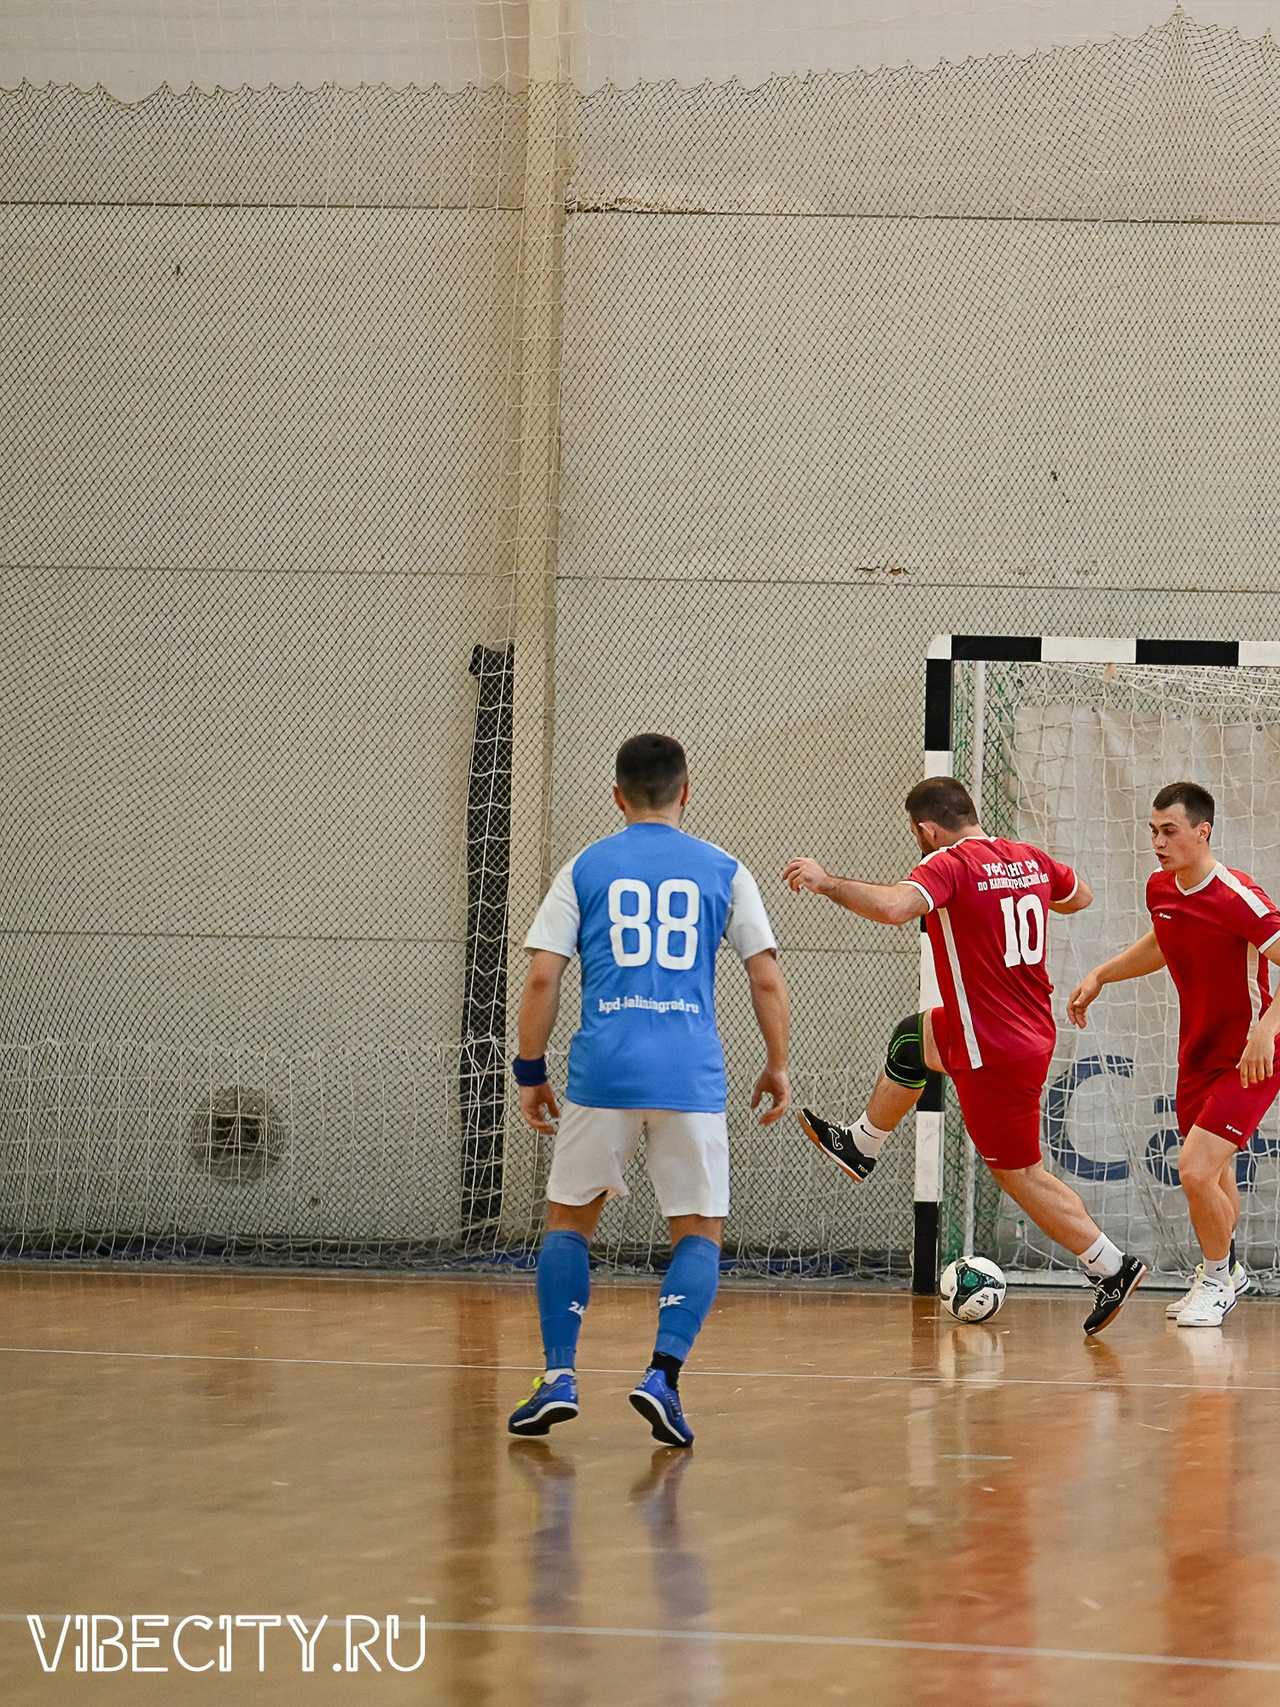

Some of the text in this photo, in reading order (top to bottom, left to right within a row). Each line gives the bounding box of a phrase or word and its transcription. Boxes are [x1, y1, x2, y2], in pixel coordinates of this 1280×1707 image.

[982, 859, 1039, 878] УФСНГ РФ
[608, 878, 700, 970] 88
[1000, 894, 1044, 968] 10
